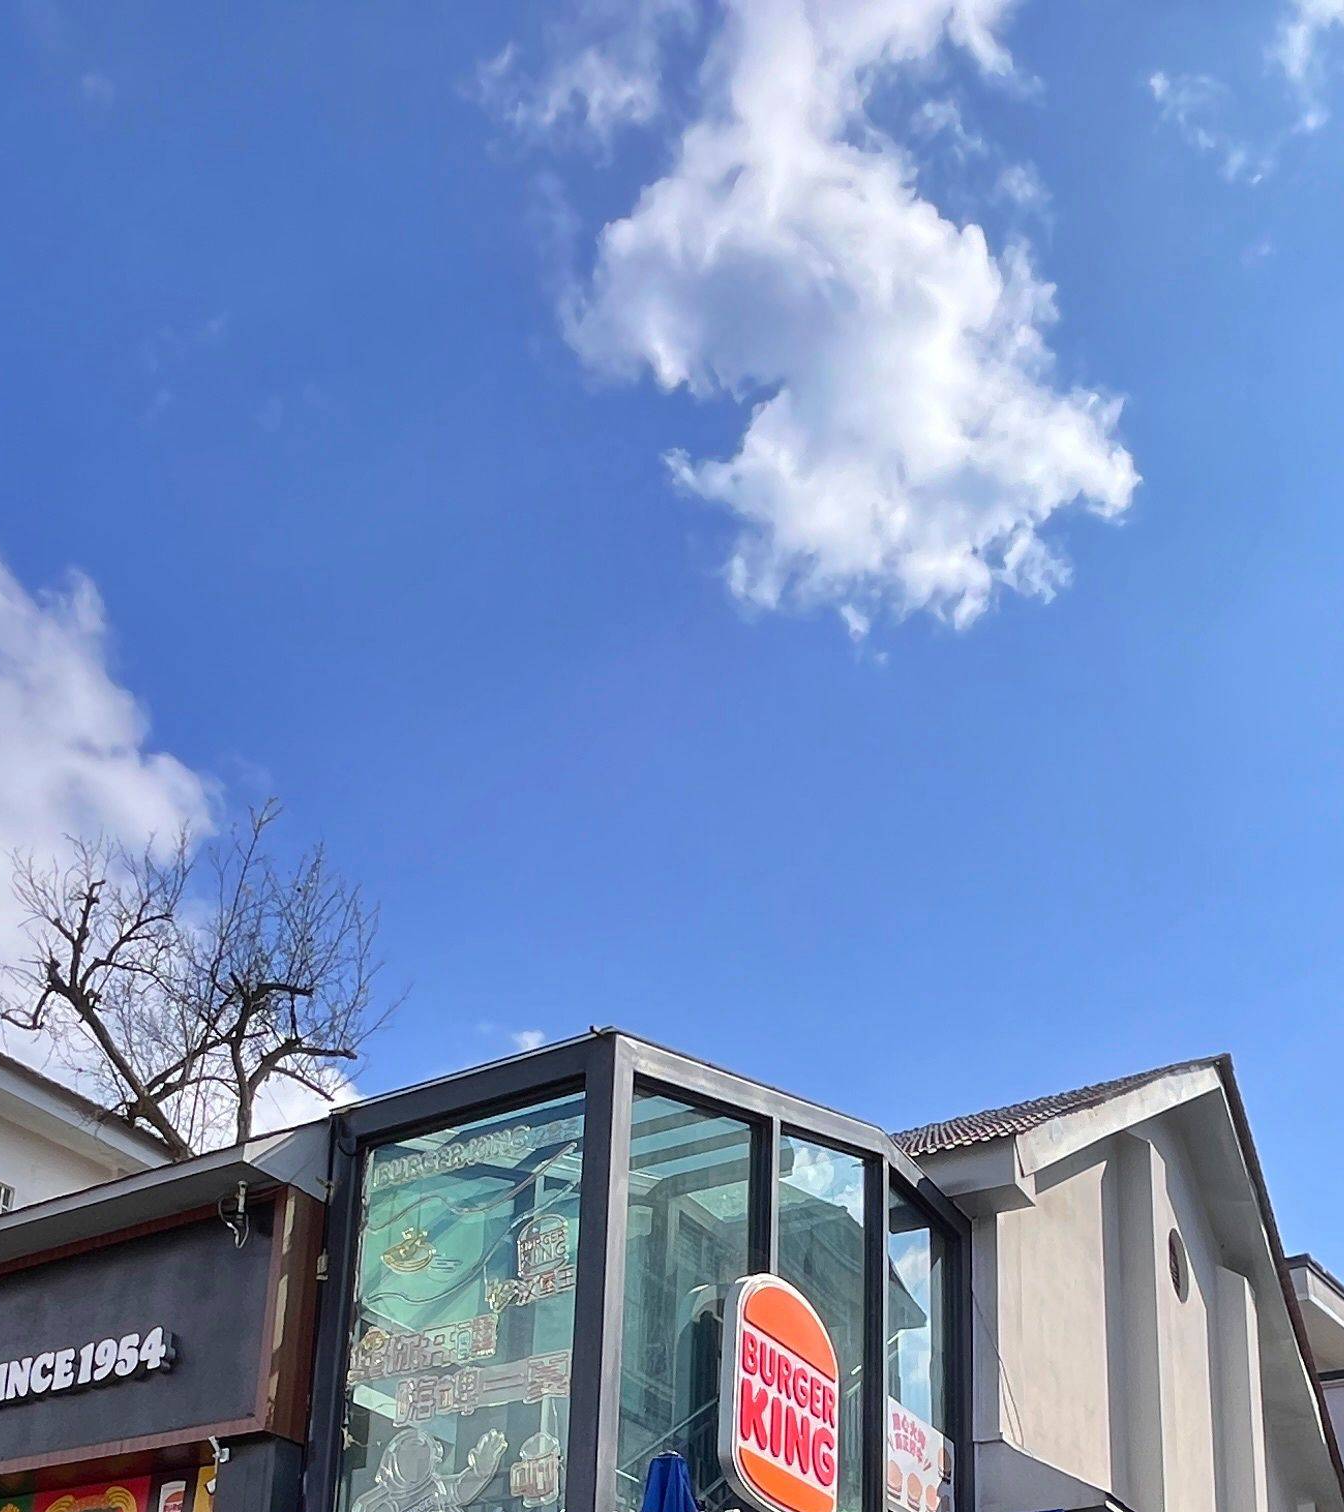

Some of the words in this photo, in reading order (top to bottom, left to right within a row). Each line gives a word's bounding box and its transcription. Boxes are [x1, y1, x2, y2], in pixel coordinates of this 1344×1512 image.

[78, 1326, 167, 1384] 1954
[741, 1330, 836, 1429] BURGER
[740, 1378, 835, 1487] KING
